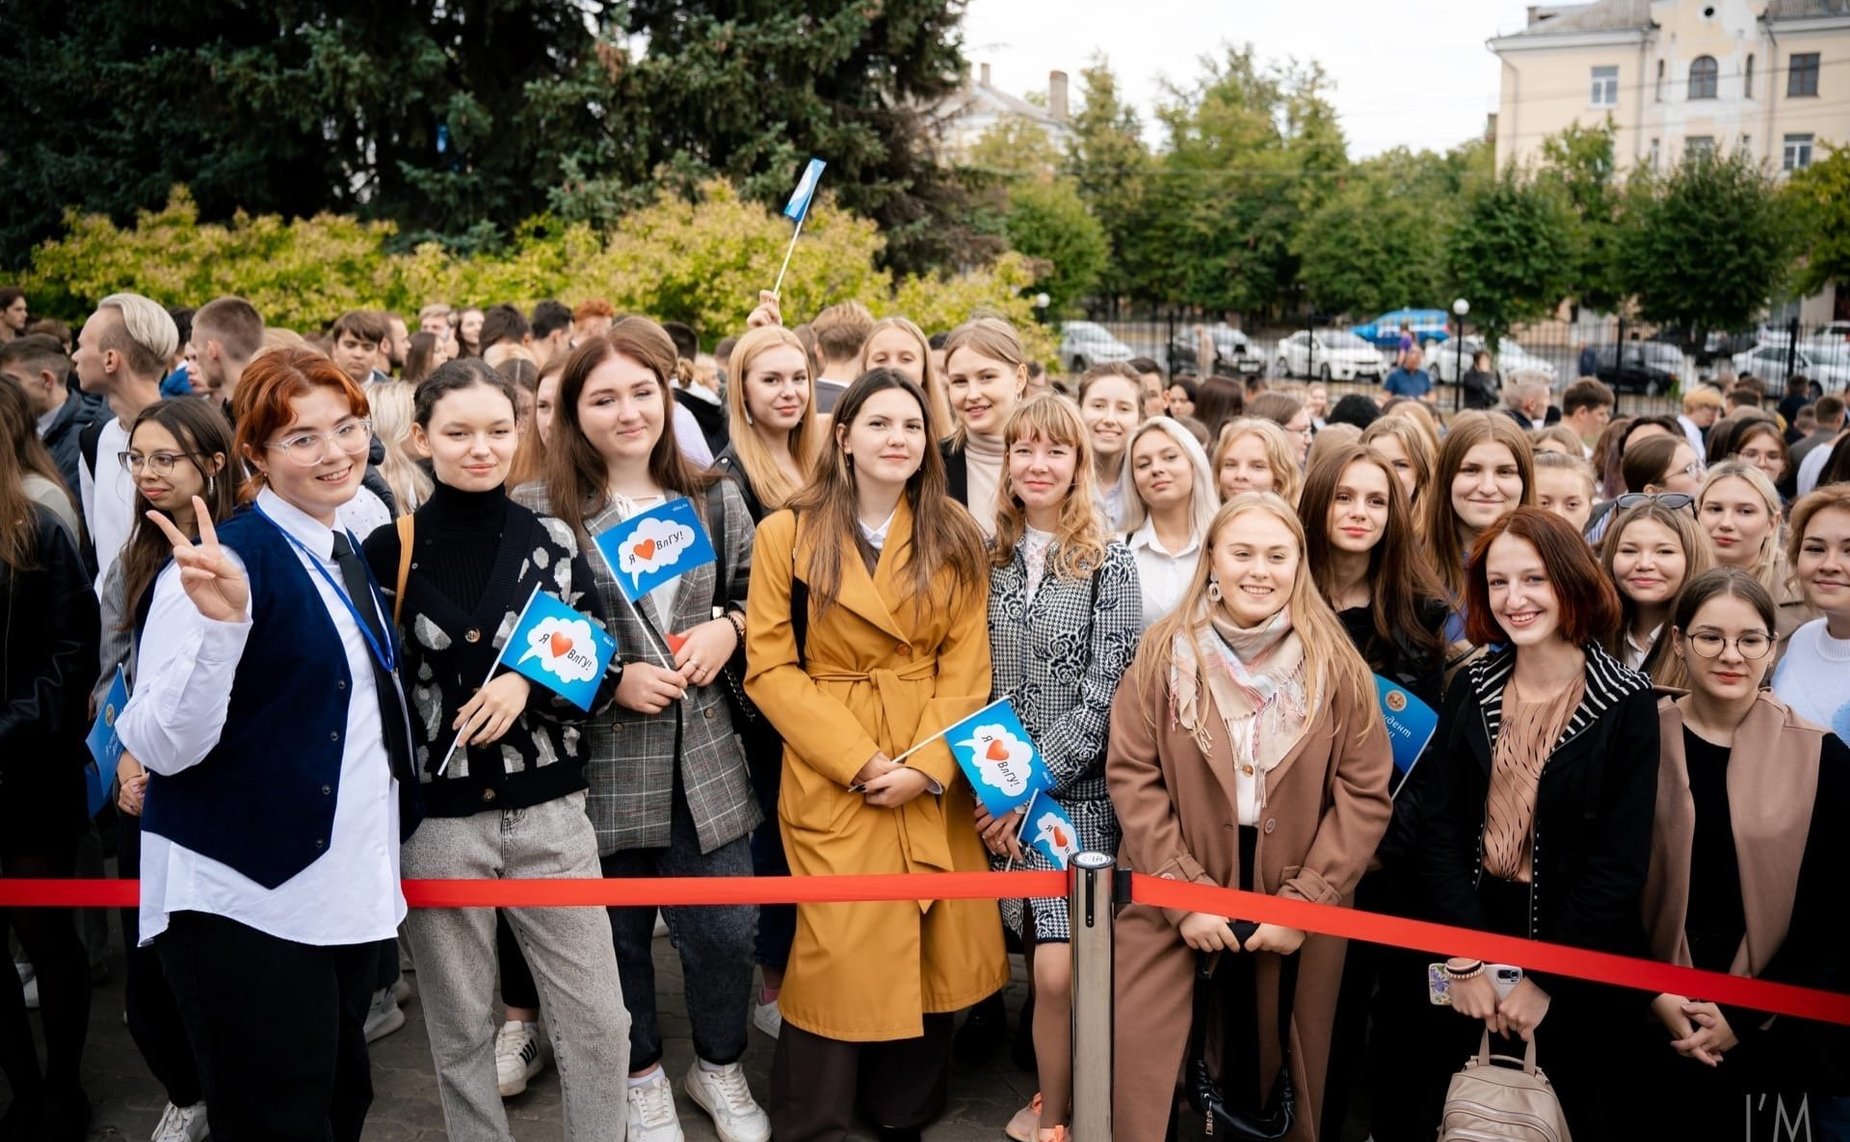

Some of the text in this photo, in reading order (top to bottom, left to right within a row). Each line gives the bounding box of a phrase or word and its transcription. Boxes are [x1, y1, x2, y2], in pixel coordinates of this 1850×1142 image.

[628, 530, 684, 565] Я ВлГУ!
[538, 633, 593, 671] Я ВлГУ!
[981, 735, 1021, 787] Я ВлГУ!
[1046, 824, 1054, 833] Я
